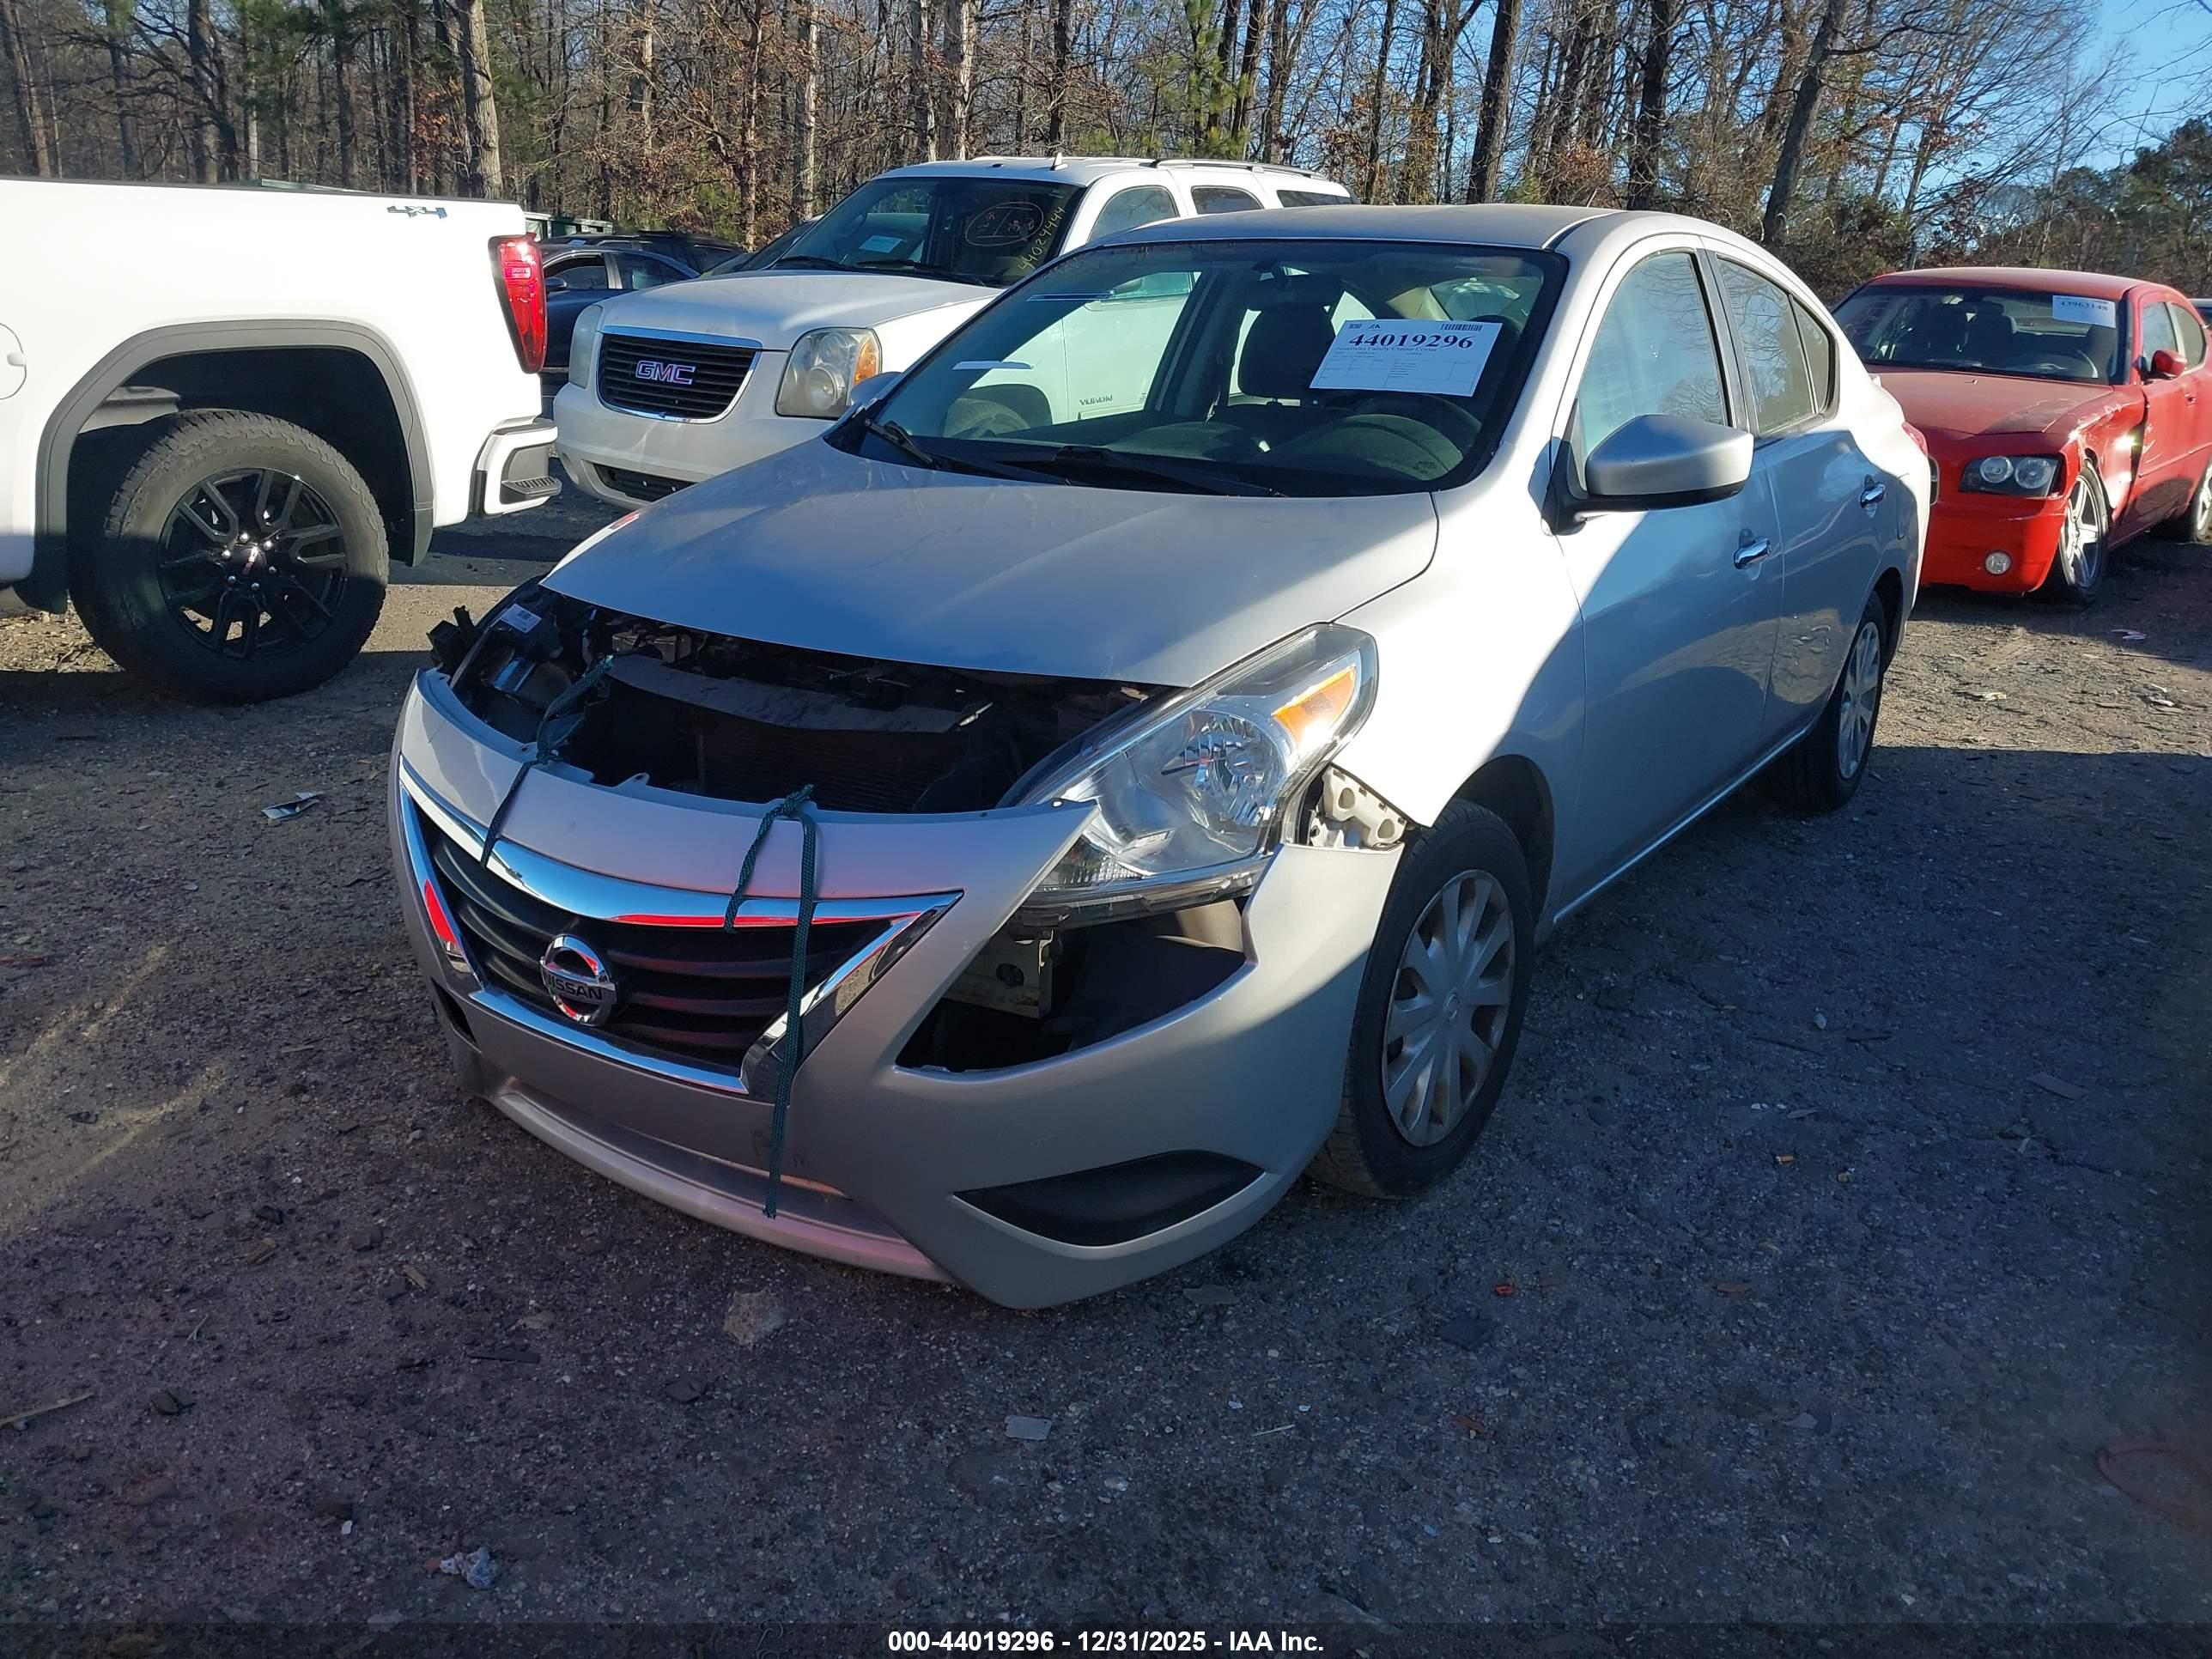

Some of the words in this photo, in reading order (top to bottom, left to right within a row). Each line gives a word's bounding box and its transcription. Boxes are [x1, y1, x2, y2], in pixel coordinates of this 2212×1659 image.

[1017, 206, 1066, 270] 44024444
[1348, 333, 1475, 349] 44019296
[635, 360, 696, 386] GMC
